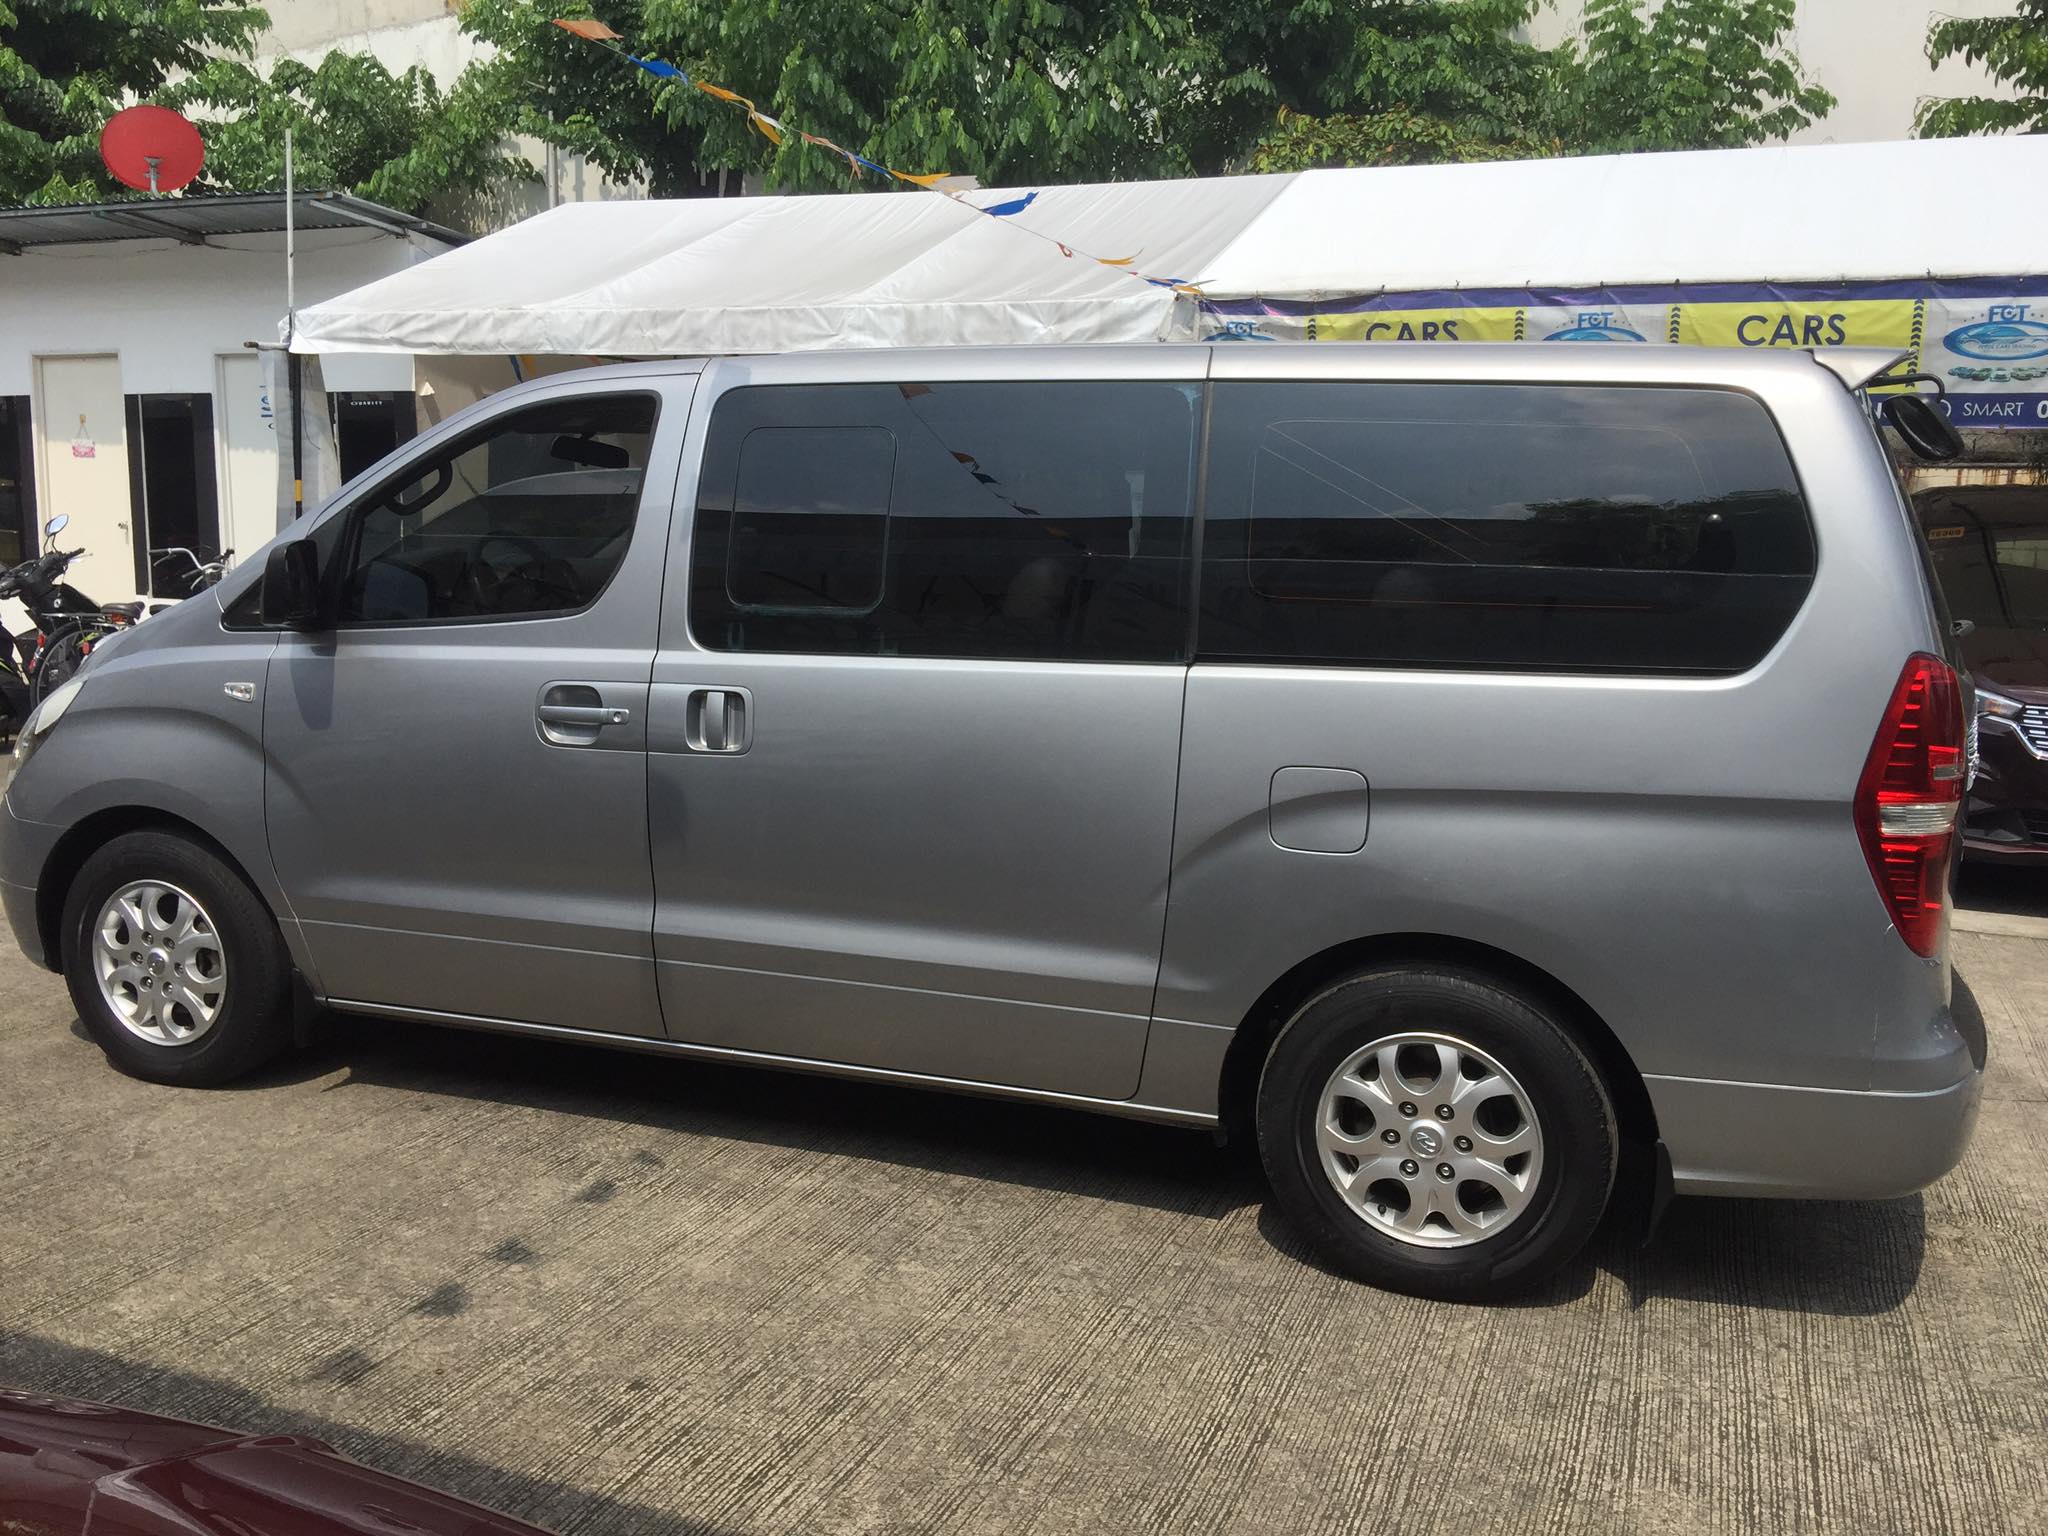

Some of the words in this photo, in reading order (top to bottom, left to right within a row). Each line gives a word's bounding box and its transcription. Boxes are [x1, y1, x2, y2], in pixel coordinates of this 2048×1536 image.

[1578, 312, 1613, 328] FCT
[1988, 304, 2031, 322] FCT
[1366, 321, 1459, 340] CARS
[1737, 314, 1846, 346] CARS
[1963, 402, 2024, 416] SMART
